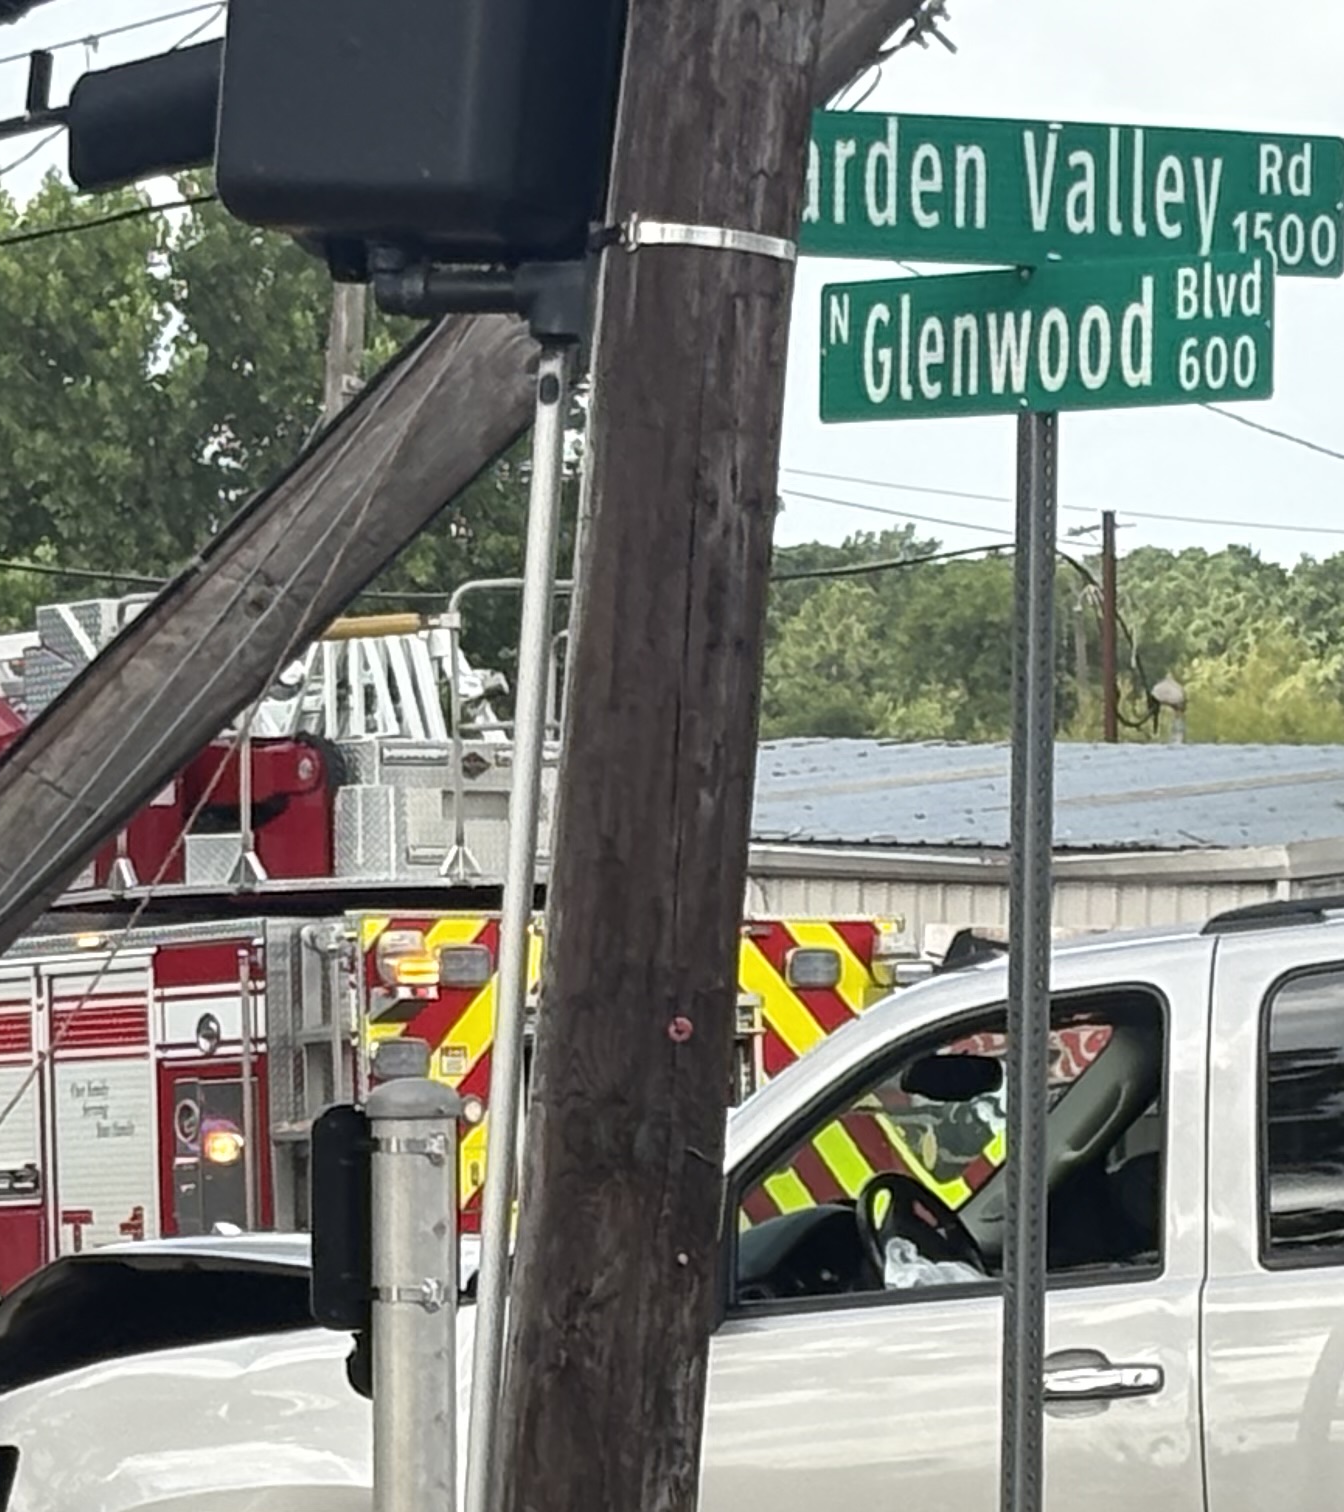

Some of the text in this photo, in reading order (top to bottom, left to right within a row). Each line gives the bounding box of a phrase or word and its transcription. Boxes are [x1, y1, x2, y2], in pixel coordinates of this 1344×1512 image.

[1022, 126, 1223, 256] Valley
[1258, 142, 1312, 197] Rd
[1232, 210, 1336, 267] 1500
[828, 257, 1262, 404] N Glenwood Blvd
[1178, 334, 1257, 391] 600
